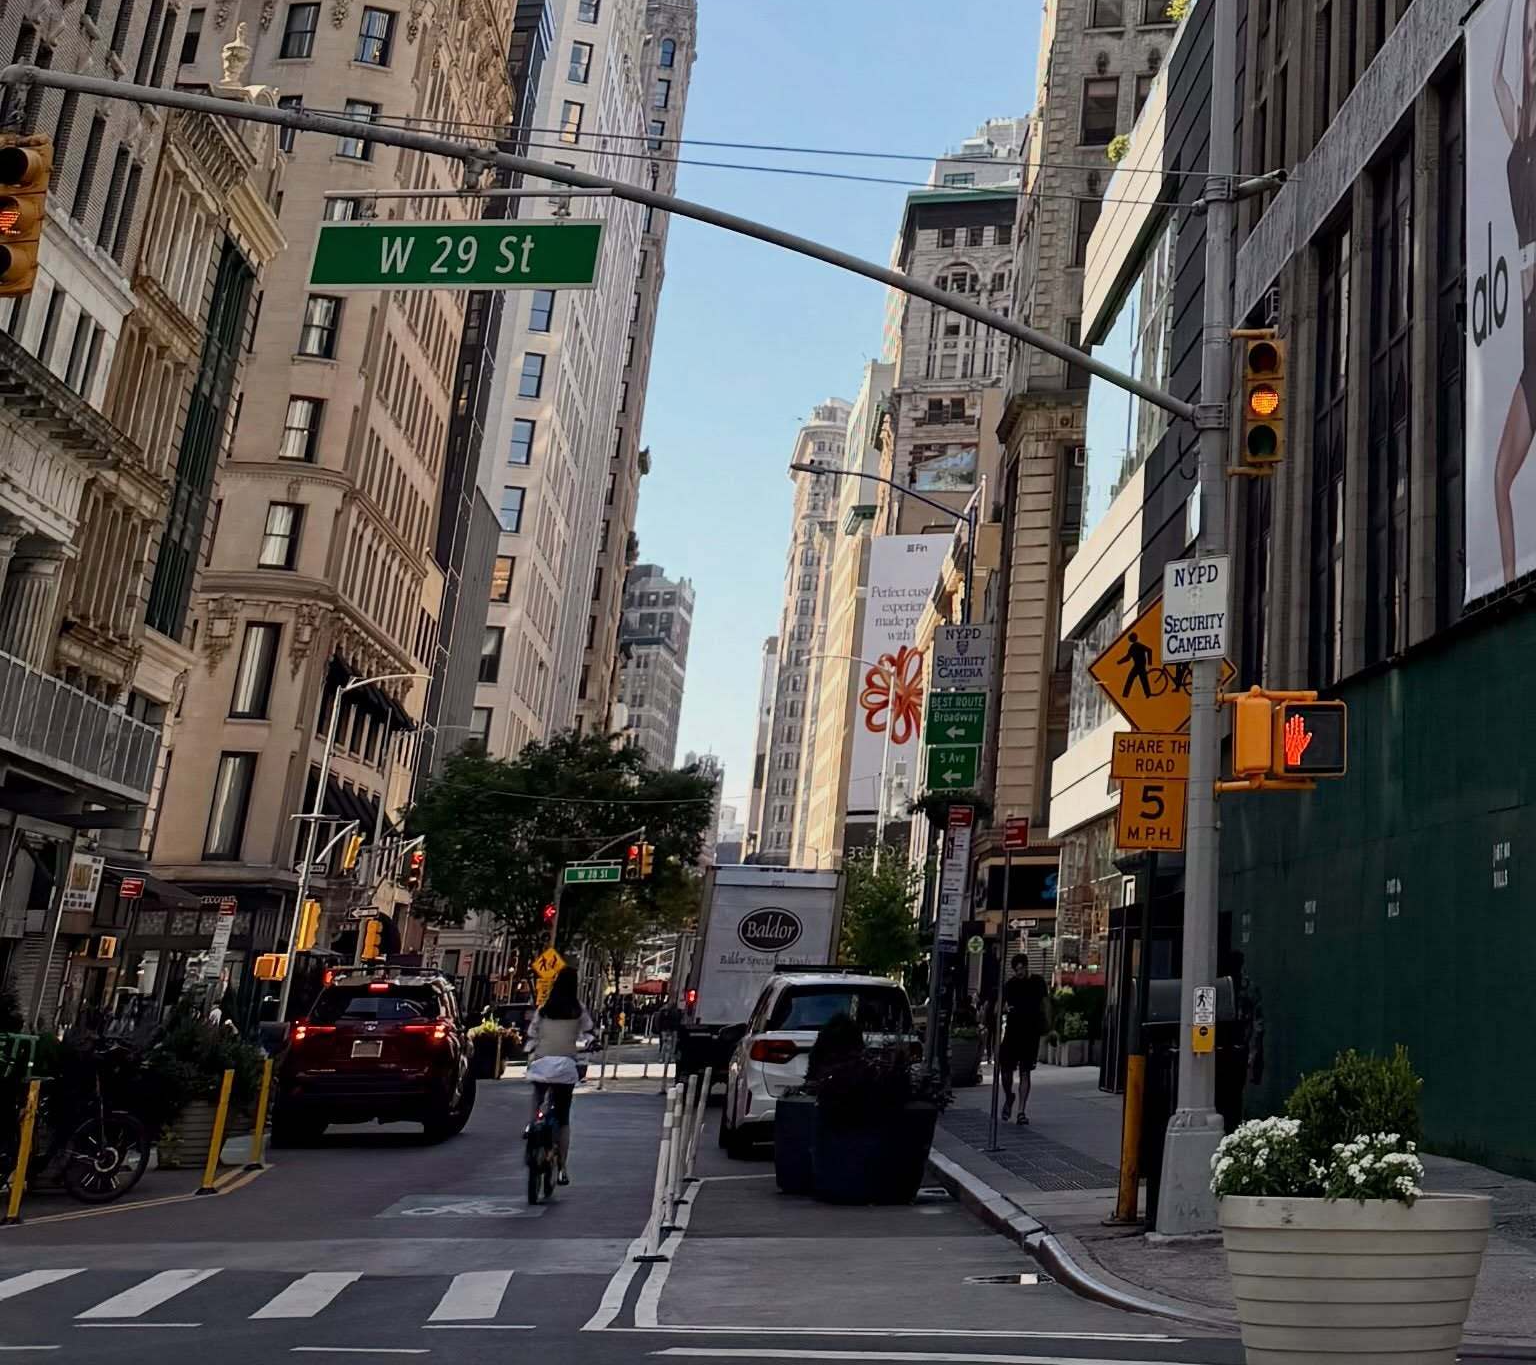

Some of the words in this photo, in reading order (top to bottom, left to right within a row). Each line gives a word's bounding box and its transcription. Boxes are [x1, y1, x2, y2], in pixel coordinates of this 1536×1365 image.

[380, 236, 415, 273] W
[430, 235, 479, 273] 29
[495, 234, 535, 273] St
[1472, 220, 1508, 348] alo
[1173, 563, 1219, 587] NYPD
[1164, 613, 1225, 634] SECURITY
[945, 628, 982, 640] NYPD
[1167, 634, 1221, 654] CAMERA
[936, 655, 987, 668] SECURITY
[938, 667, 984, 678] CAMERA
[931, 696, 953, 709] BEST
[955, 695, 985, 707] ROUTE
[934, 711, 979, 724] Broadway
[1118, 739, 1164, 754] SHARE
[1135, 758, 1175, 773] ROAD
[1139, 785, 1164, 820] 5
[746, 914, 796, 939] Baldor
